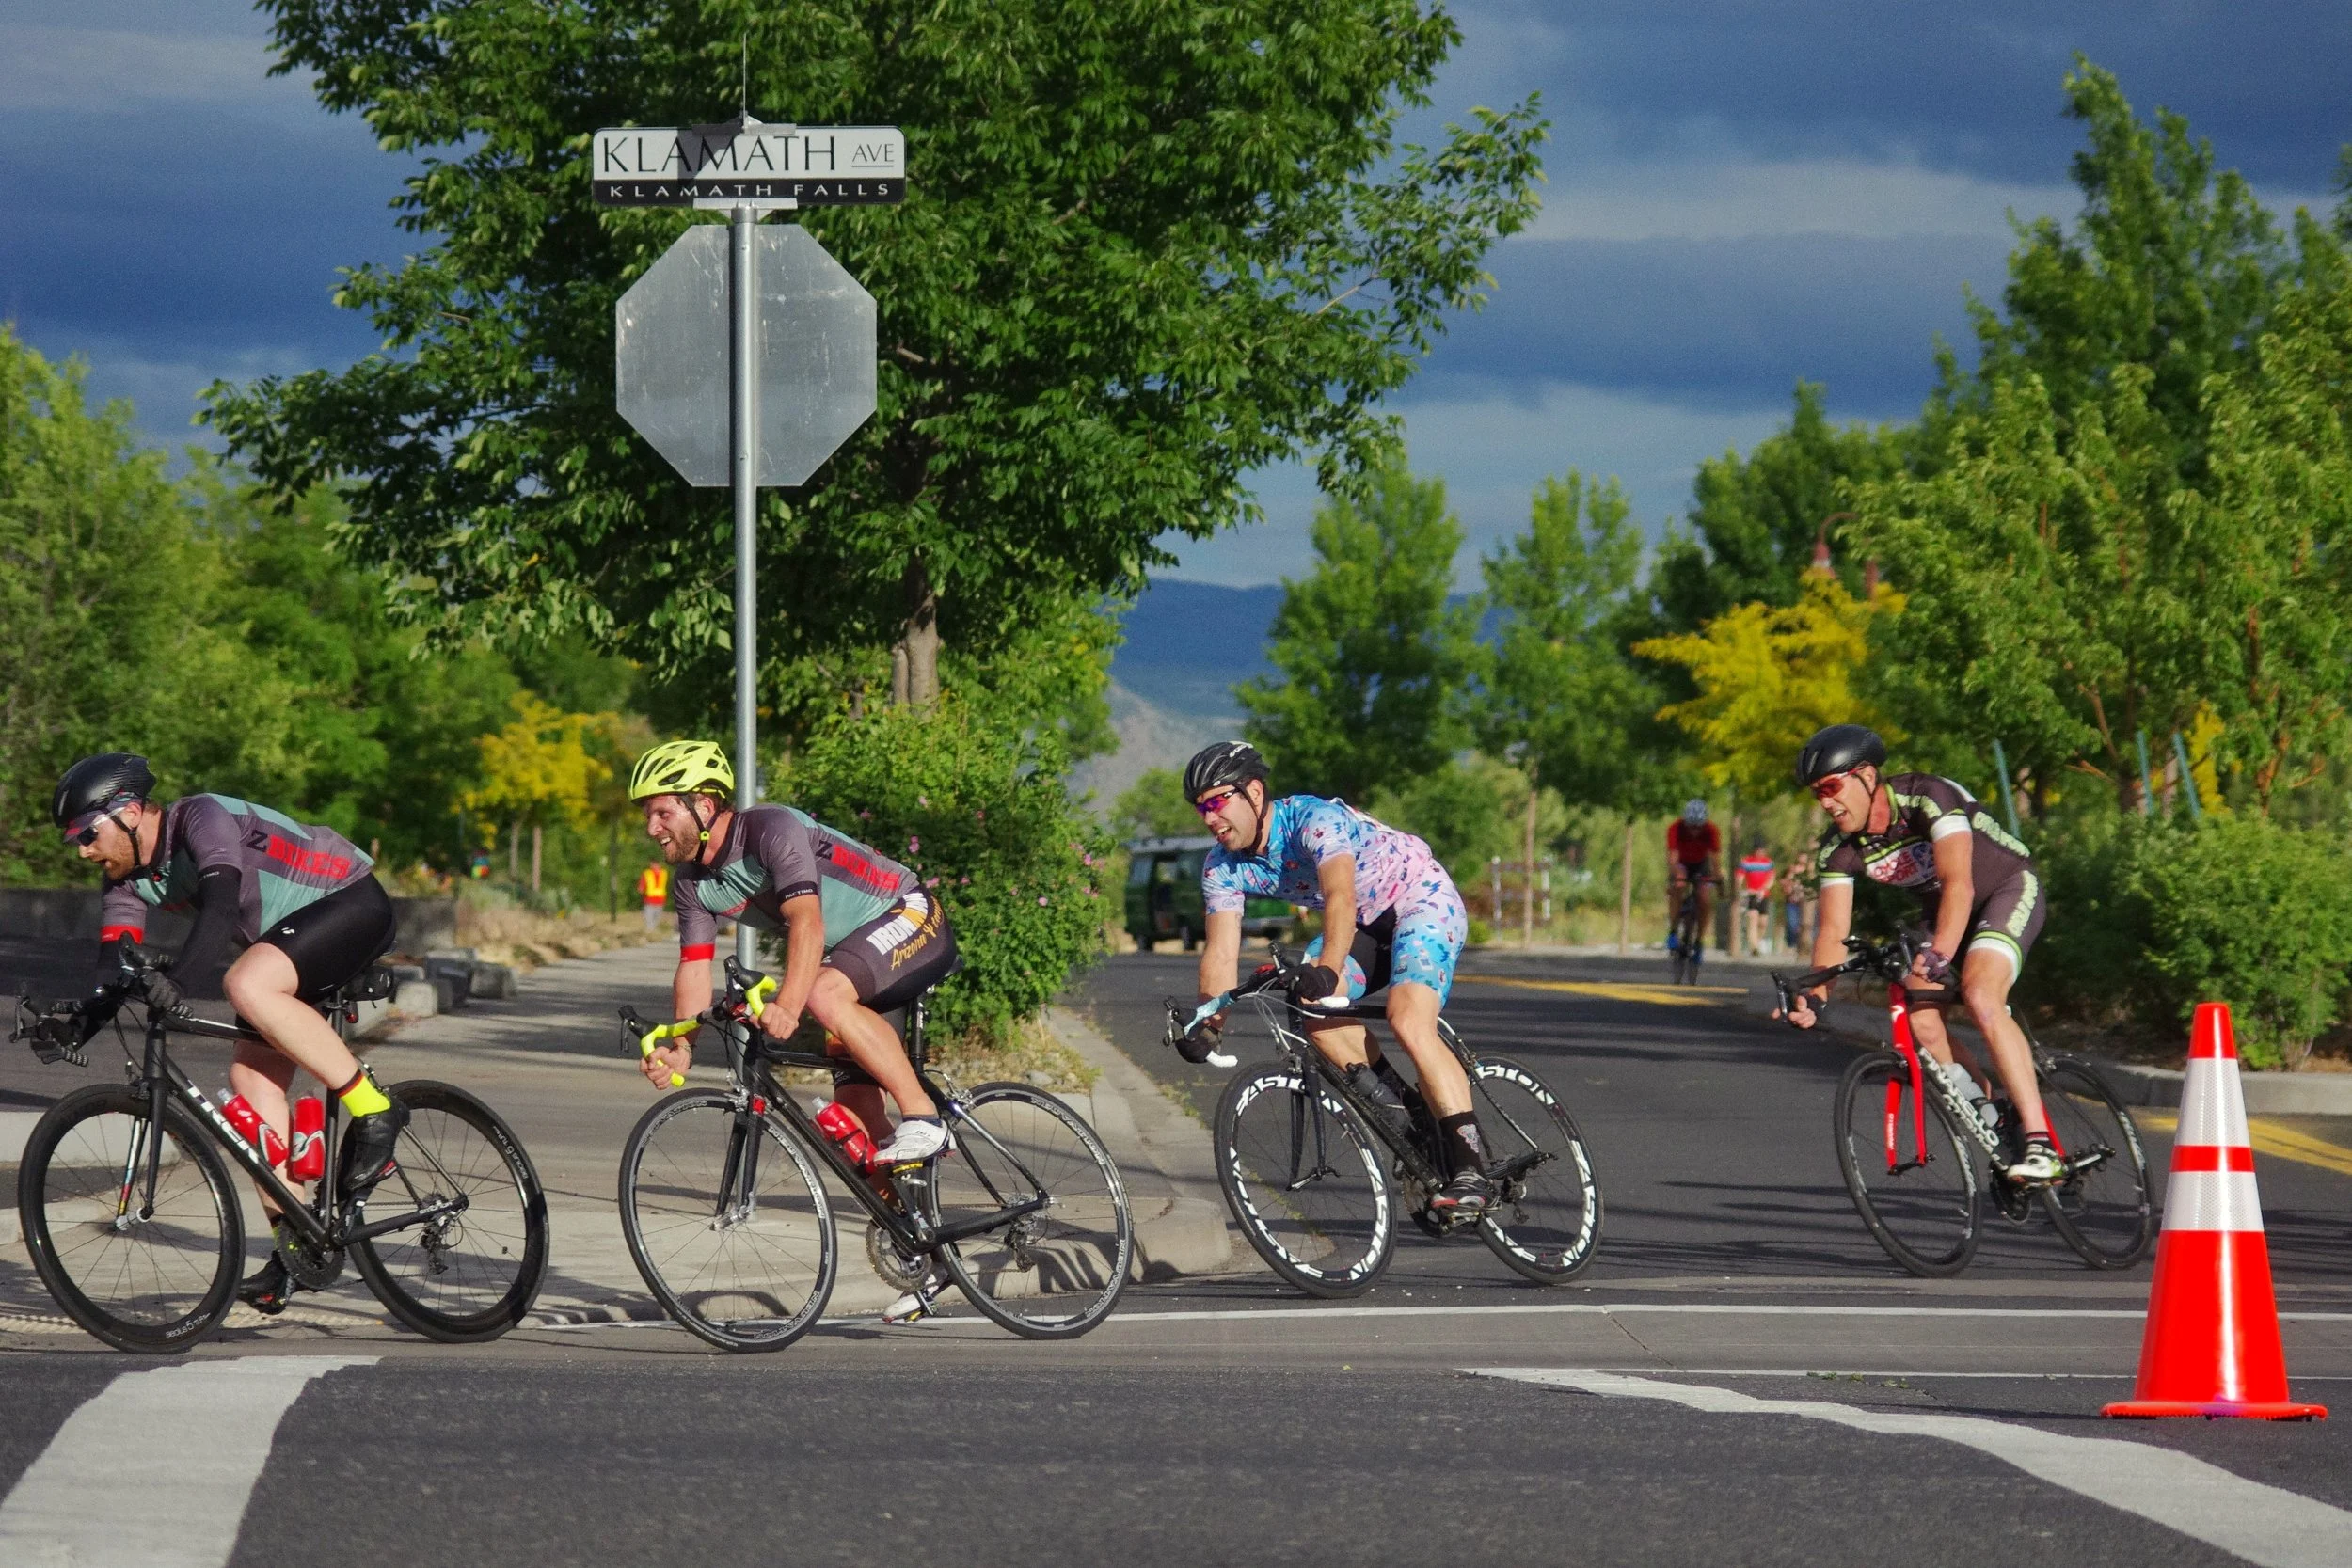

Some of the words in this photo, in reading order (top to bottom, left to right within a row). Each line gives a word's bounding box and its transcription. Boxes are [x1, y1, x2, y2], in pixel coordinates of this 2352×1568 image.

[603, 135, 835, 173] KLAMATH
[851, 143, 894, 163] AVE
[610, 184, 771, 198] KLAMATH
[794, 183, 889, 197] FALLS
[785, 888, 814, 899] PACTIMO
[1918, 1046, 2000, 1148] PINARELLO
[188, 1081, 260, 1164] TREK
